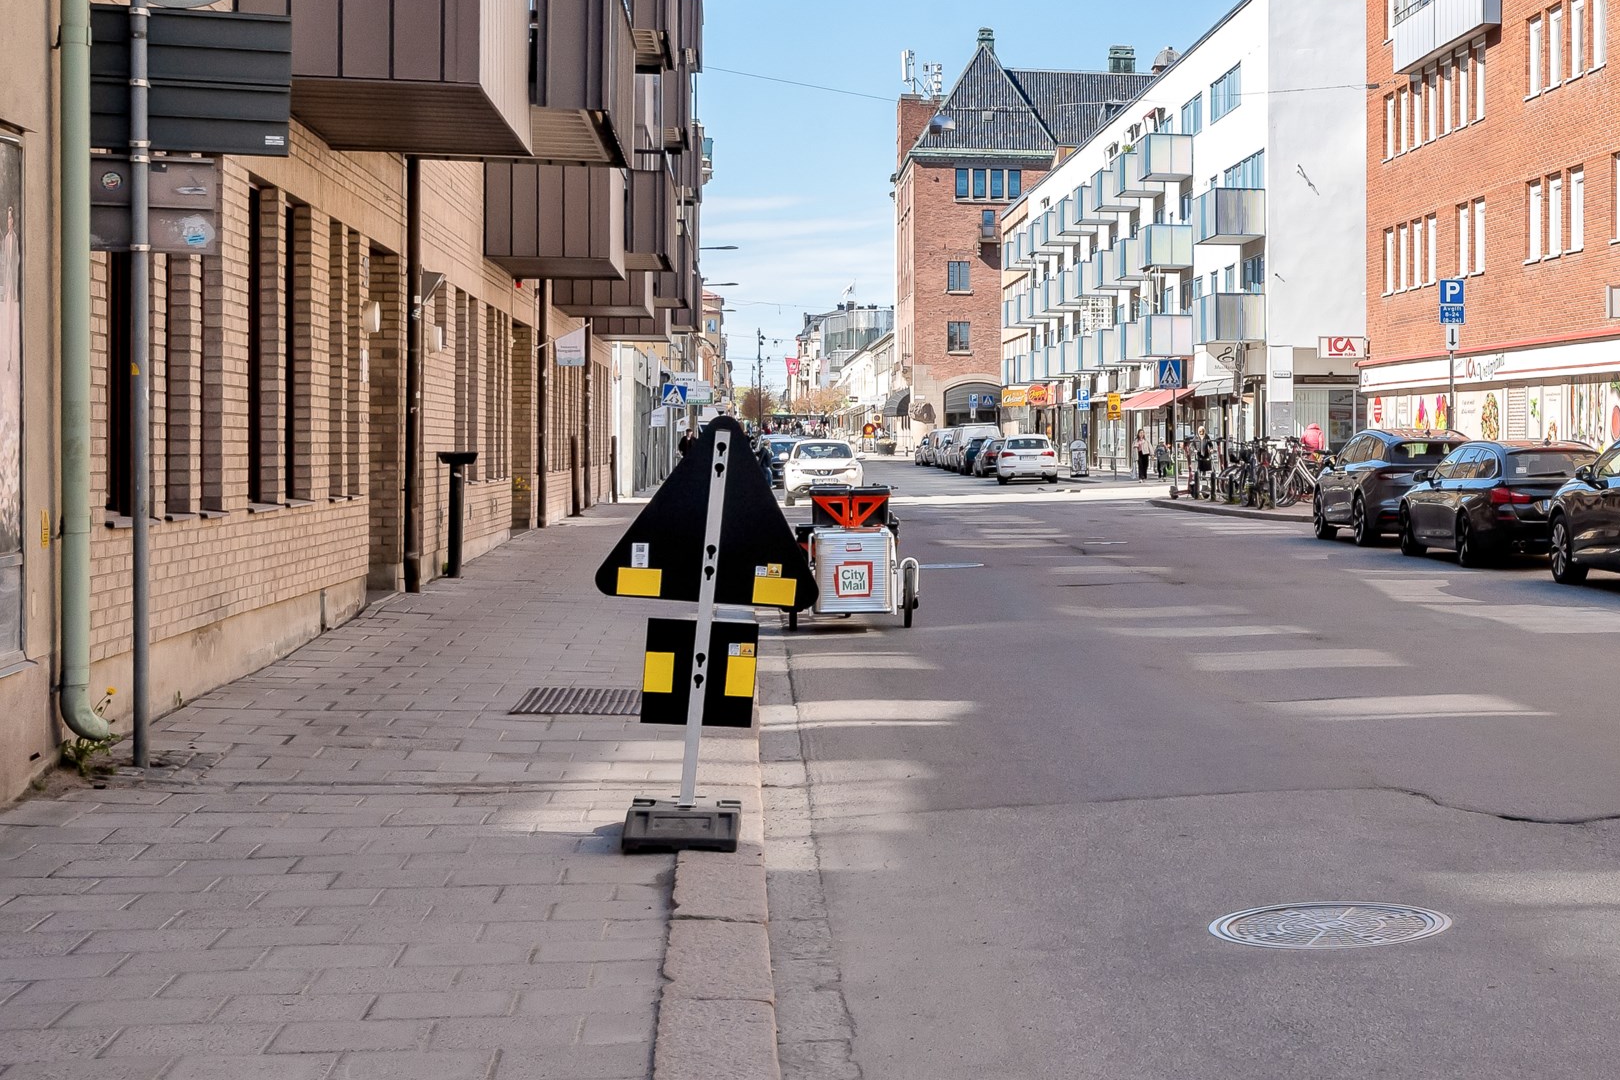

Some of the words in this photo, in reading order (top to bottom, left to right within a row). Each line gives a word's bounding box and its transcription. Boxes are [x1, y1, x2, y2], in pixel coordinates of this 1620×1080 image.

[1445, 281, 1461, 303] P
[1328, 337, 1356, 352] ICA
[1465, 357, 1476, 379] ICA
[970, 394, 977, 402] P
[1080, 390, 1088, 400] P
[841, 569, 865, 582] City
[842, 580, 866, 591] Mail
